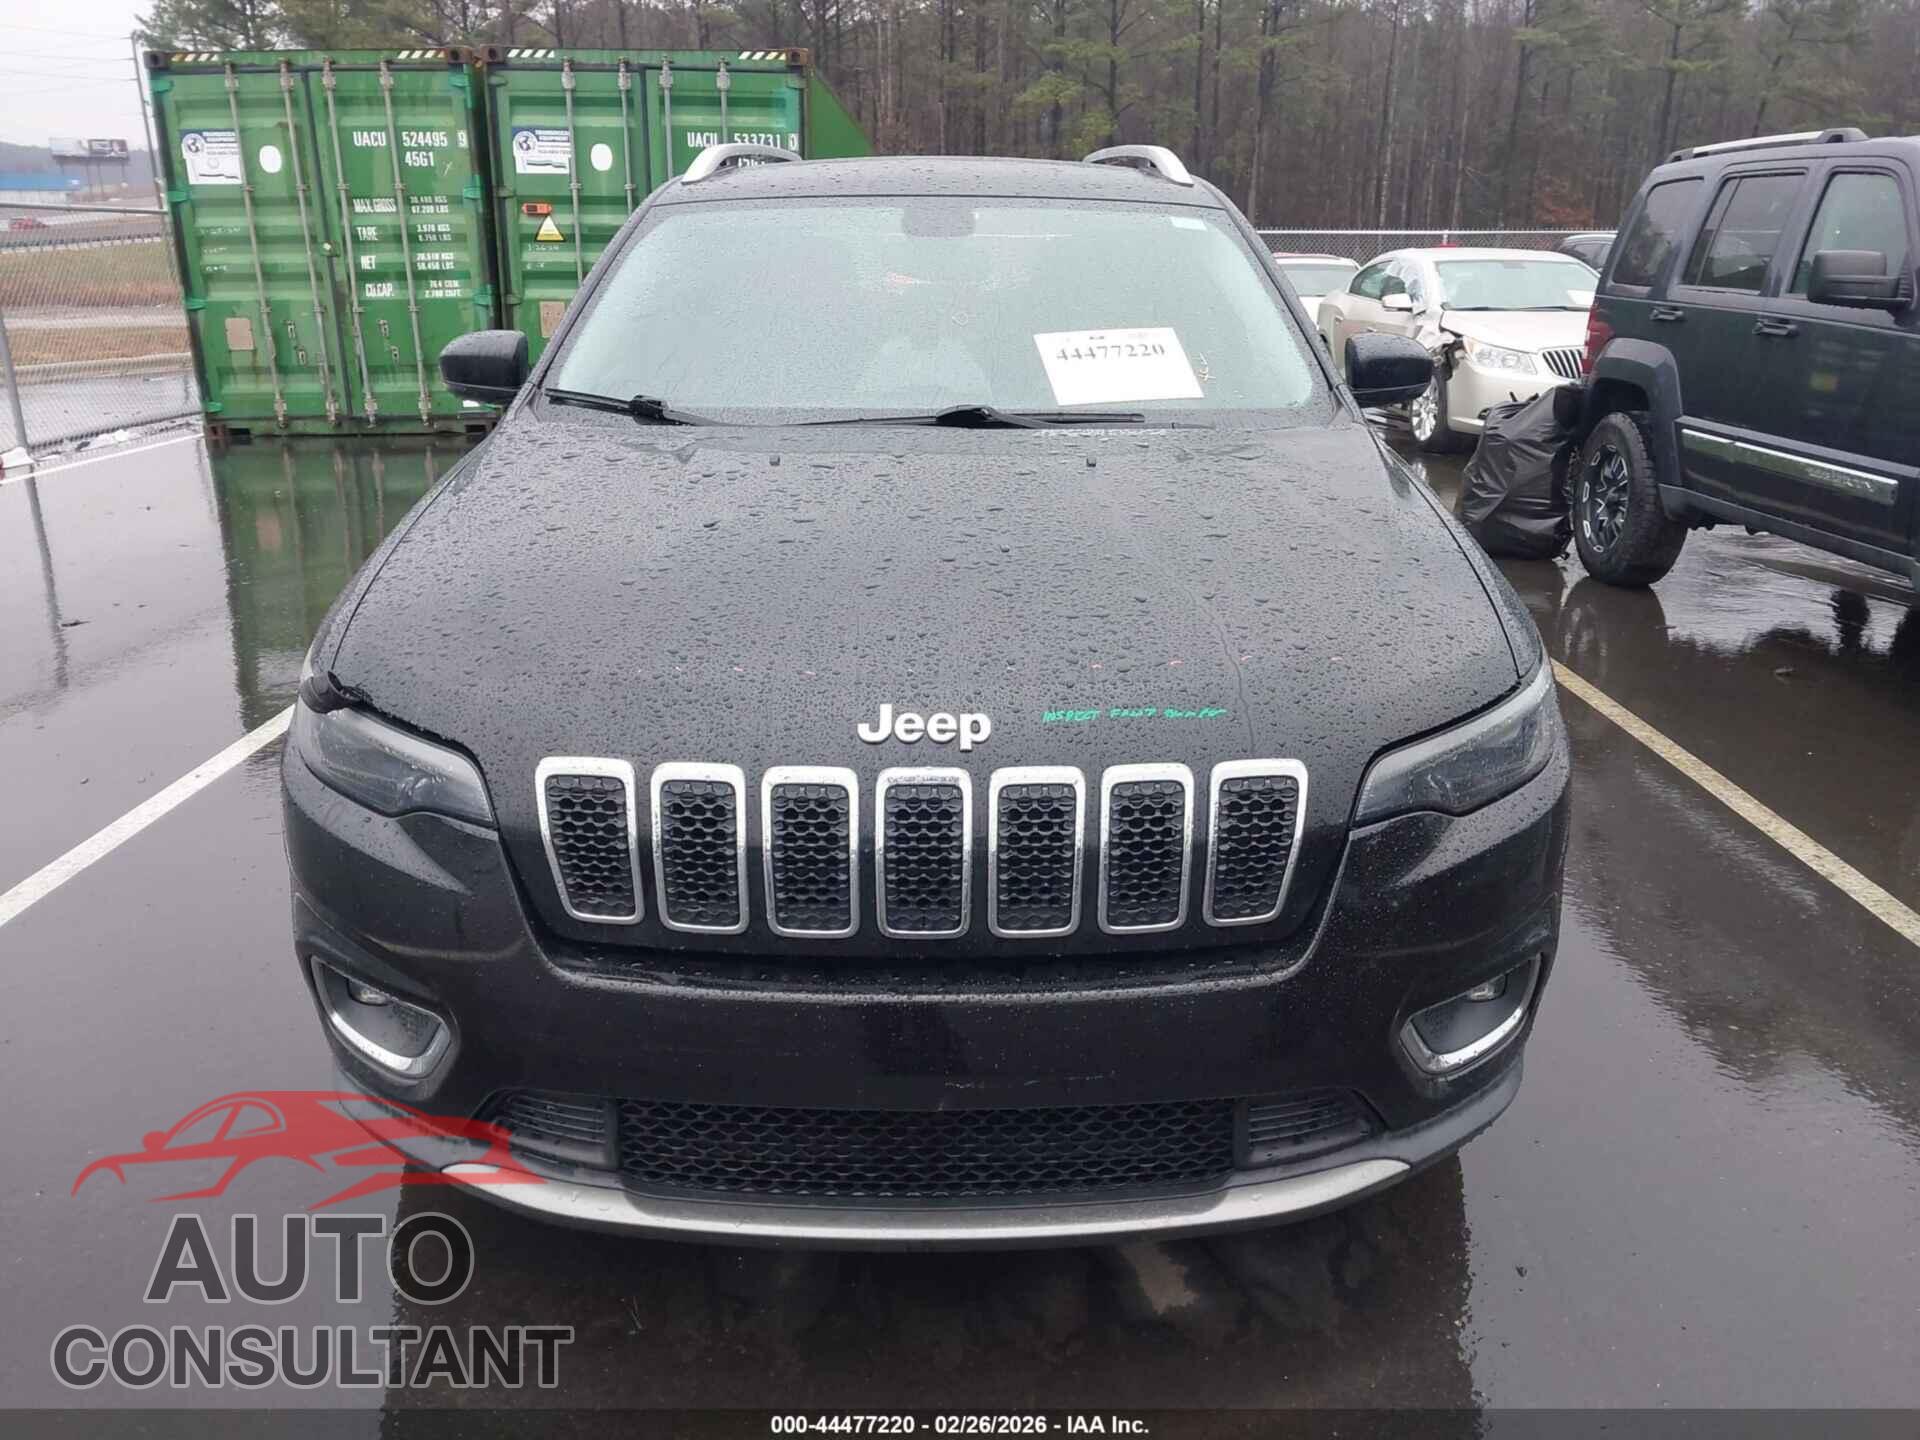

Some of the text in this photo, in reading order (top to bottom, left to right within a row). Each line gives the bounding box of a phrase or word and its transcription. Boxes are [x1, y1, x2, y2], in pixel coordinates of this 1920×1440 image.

[353, 131, 387, 147] UACU
[401, 131, 449, 147] 524495
[1056, 343, 1166, 361] 44477220
[857, 703, 992, 752] Jeep
